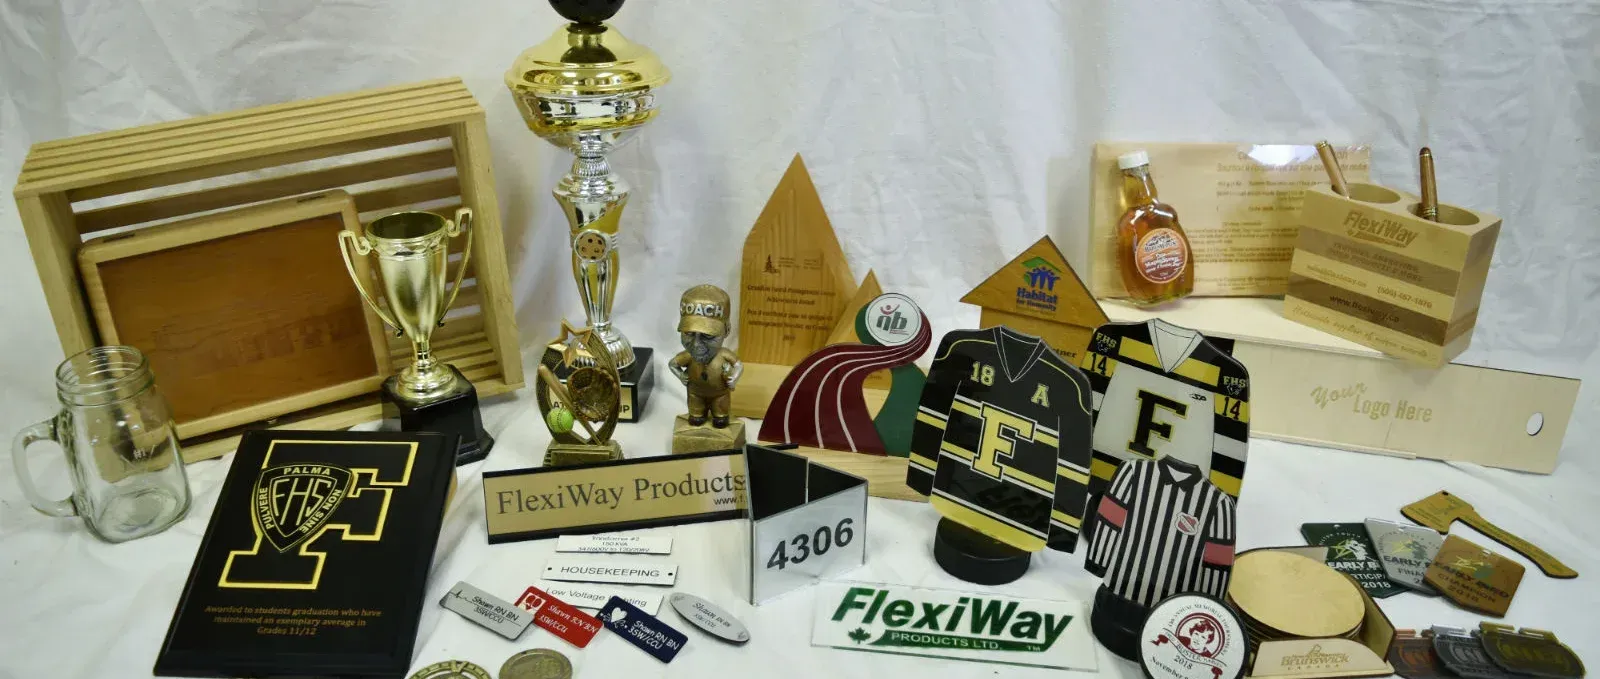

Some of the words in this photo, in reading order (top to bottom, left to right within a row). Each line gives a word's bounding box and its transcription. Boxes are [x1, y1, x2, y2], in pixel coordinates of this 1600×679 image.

[1343, 210, 1418, 245] FlexiWay
[1016, 287, 1057, 304] Habitat
[680, 302, 724, 317] COACH
[1027, 301, 1056, 312] Humanity
[876, 311, 908, 331] nb
[1096, 332, 1117, 349] FHS
[970, 361, 996, 387] 18
[1090, 352, 1107, 376] 14
[1223, 375, 1247, 388] FHS
[1030, 382, 1050, 408] A
[1310, 382, 1368, 411] Your
[1222, 396, 1241, 421] 14
[1352, 394, 1391, 420] Logo
[1394, 399, 1433, 423] Here
[1126, 387, 1190, 460] F
[970, 400, 1038, 483] F
[283, 466, 331, 476] PALMA
[272, 477, 332, 526] FHS
[322, 488, 343, 511] NON
[496, 482, 625, 516] FlexiWay
[633, 472, 747, 501] Products
[259, 487, 274, 530] PULVERE
[299, 510, 325, 534] SINE
[766, 517, 854, 570] 4306
[1328, 561, 1366, 571] EARLY
[1383, 554, 1421, 567] EARLY
[560, 566, 660, 578] HOUSEKEEPING
[546, 587, 566, 597] Low
[570, 589, 606, 602] Voltage
[1362, 581, 1391, 589] 2018
[204, 605, 243, 613] Awarded
[244, 606, 253, 614] to
[254, 607, 291, 615] students
[292, 607, 338, 616] graduation
[361, 609, 382, 617] have
[831, 586, 1074, 648] FlexiWay
[213, 616, 262, 624] maintained
[276, 617, 320, 627] exemplary
[321, 620, 356, 628] average
[257, 627, 287, 635] Grades
[289, 627, 317, 635] 11/12
[633, 620, 655, 637] Shawn
[656, 631, 669, 644] RN
[666, 638, 680, 650] BN
[891, 632, 969, 647] PRODUCTS
[972, 640, 1001, 650] LTD.
[1173, 655, 1193, 670] 2018
[1281, 654, 1349, 666] Brunswick
